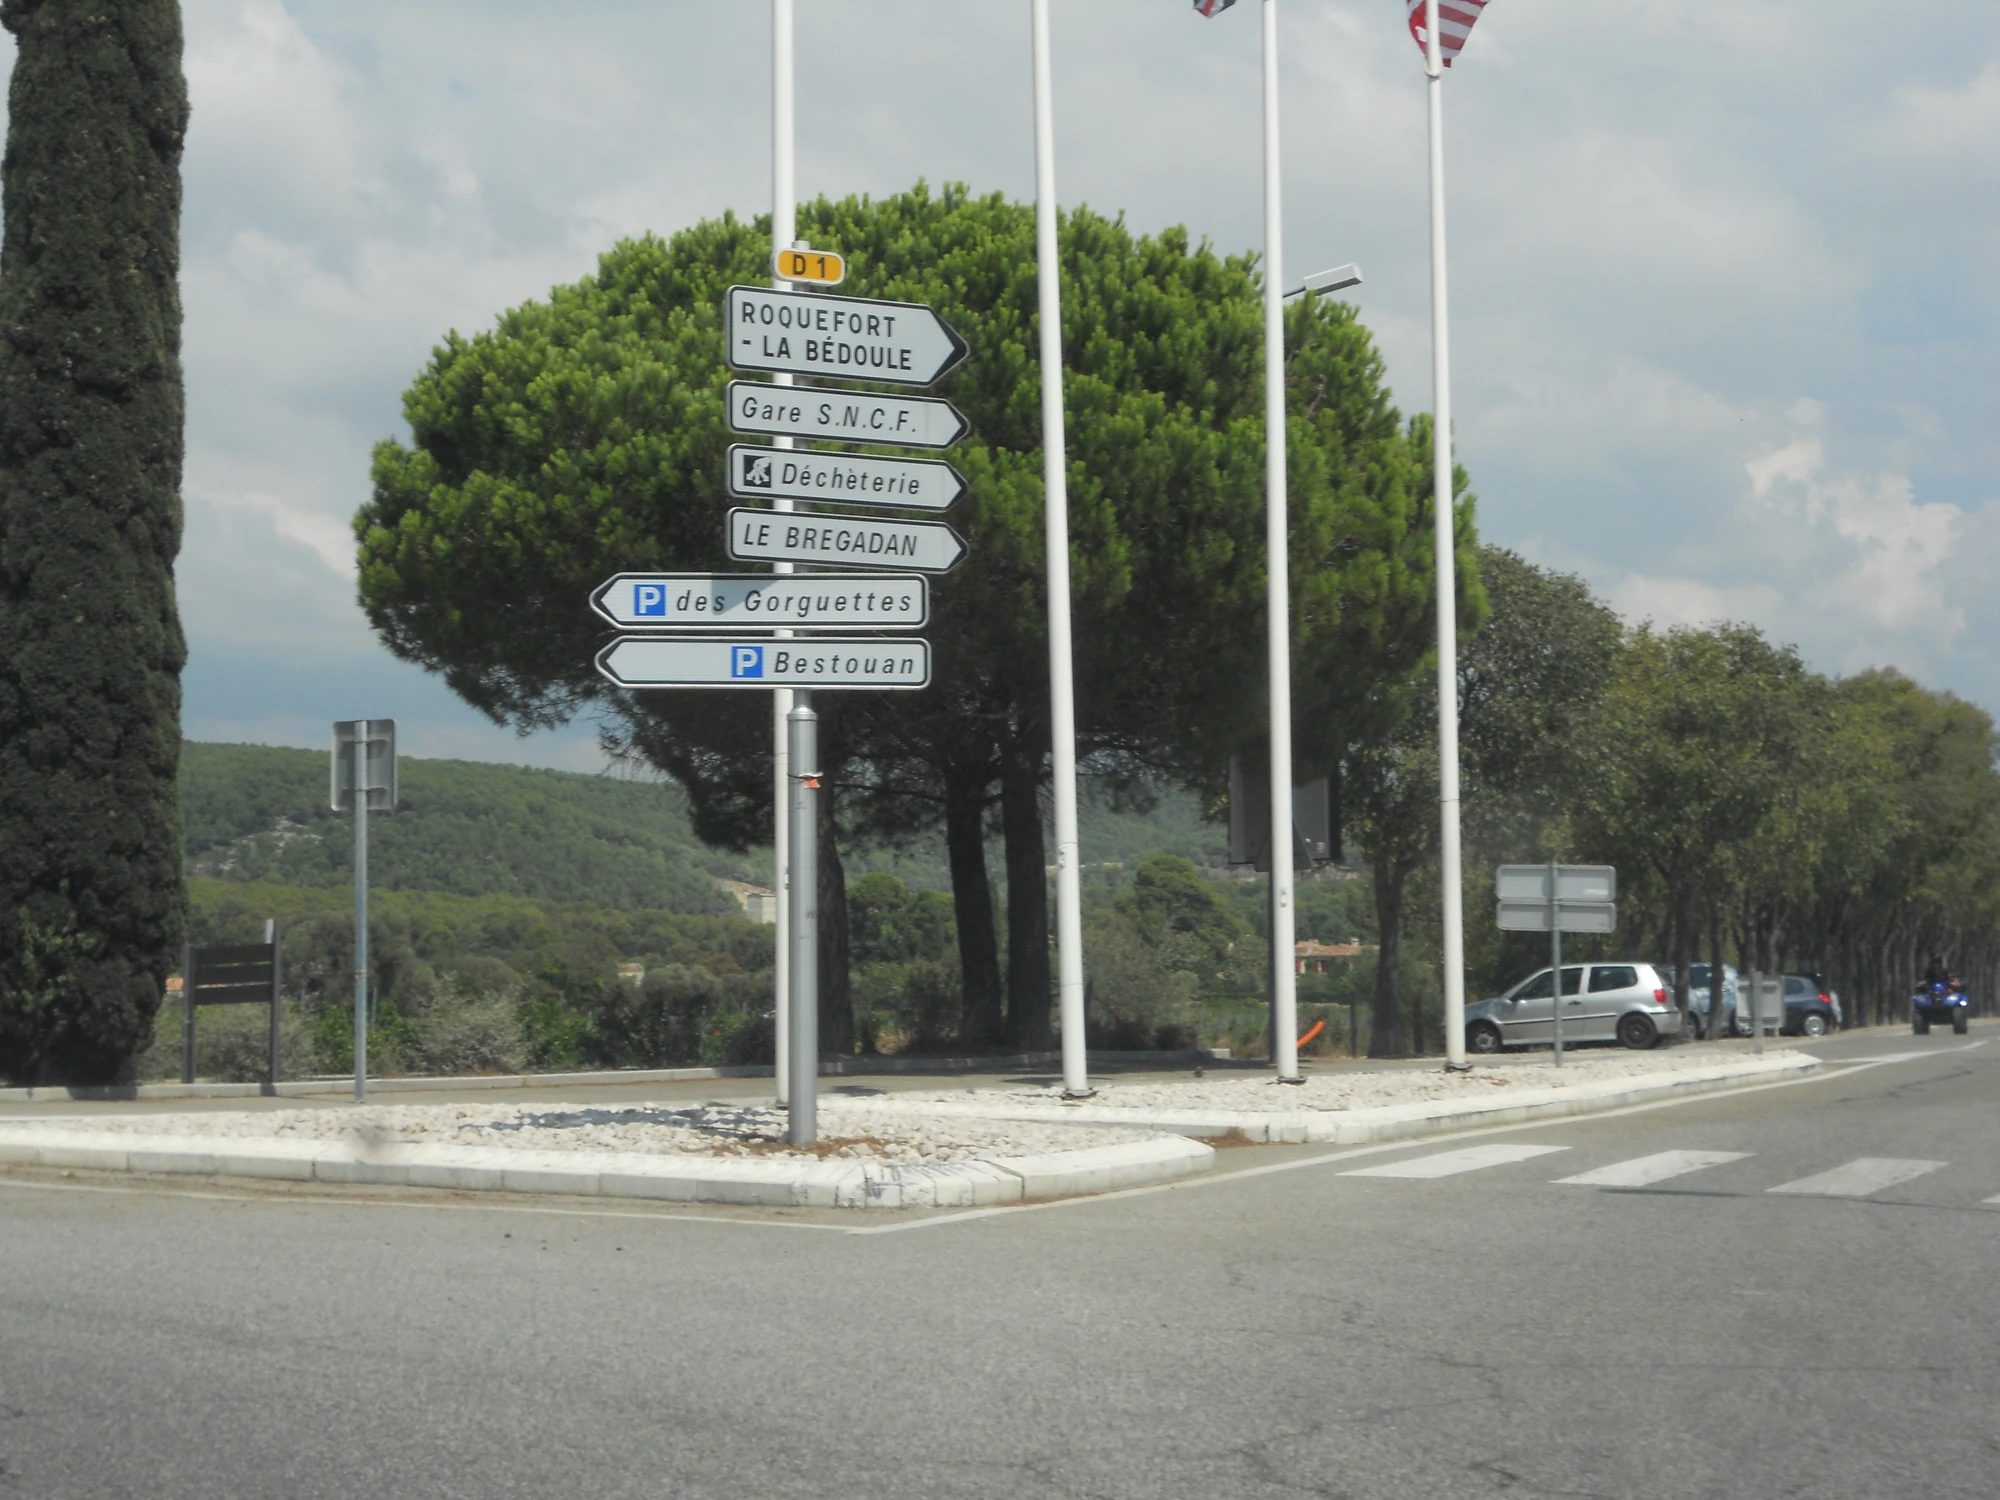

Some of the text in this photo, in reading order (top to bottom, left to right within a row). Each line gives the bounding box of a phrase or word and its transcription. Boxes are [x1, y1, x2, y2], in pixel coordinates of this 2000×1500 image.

[742, 301, 895, 337] ROQUEFORT
[763, 335, 791, 359] LA
[806, 336, 912, 371] BÉDOULE
[742, 397, 916, 432] Gare S.N.C.F.
[782, 463, 920, 494] Déchèterie
[744, 524, 918, 556] LE BREGADAN
[638, 586, 911, 617] P des Gorguettes
[736, 648, 914, 676] P Bestouan
